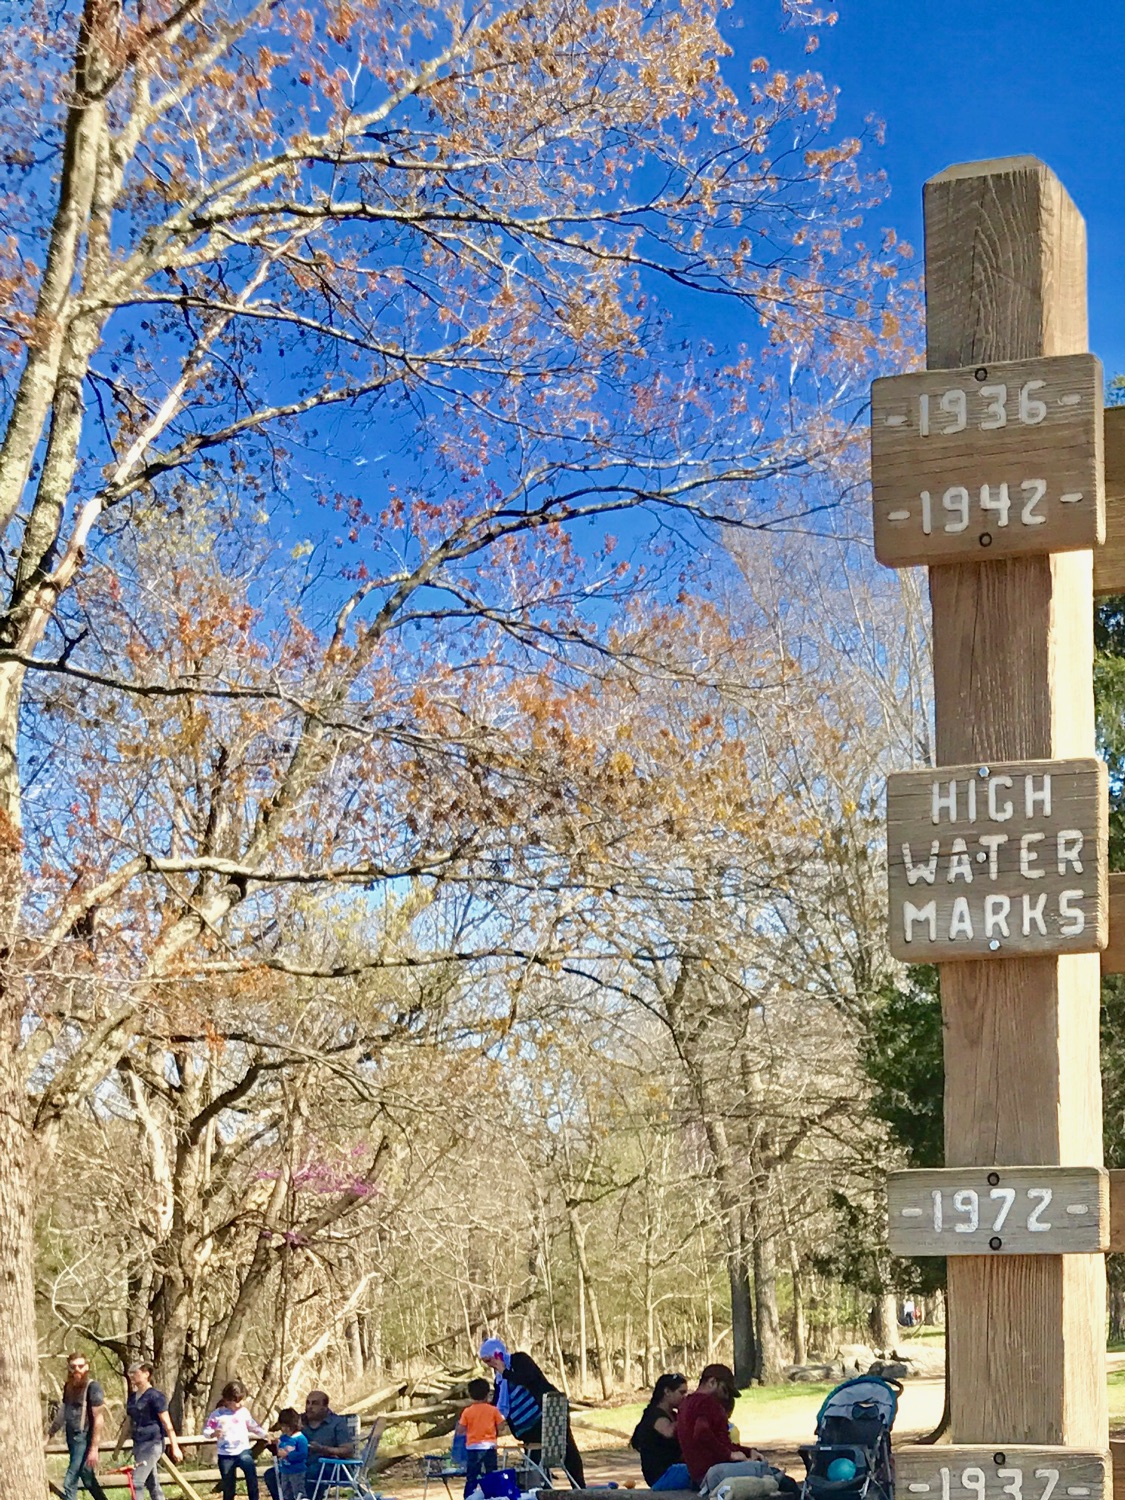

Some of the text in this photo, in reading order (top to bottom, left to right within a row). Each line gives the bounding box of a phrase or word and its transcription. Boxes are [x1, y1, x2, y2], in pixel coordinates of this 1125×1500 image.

[931, 773, 1052, 825] HIGH
[902, 829, 1085, 885] WATER
[903, 889, 1086, 943] MARKS
